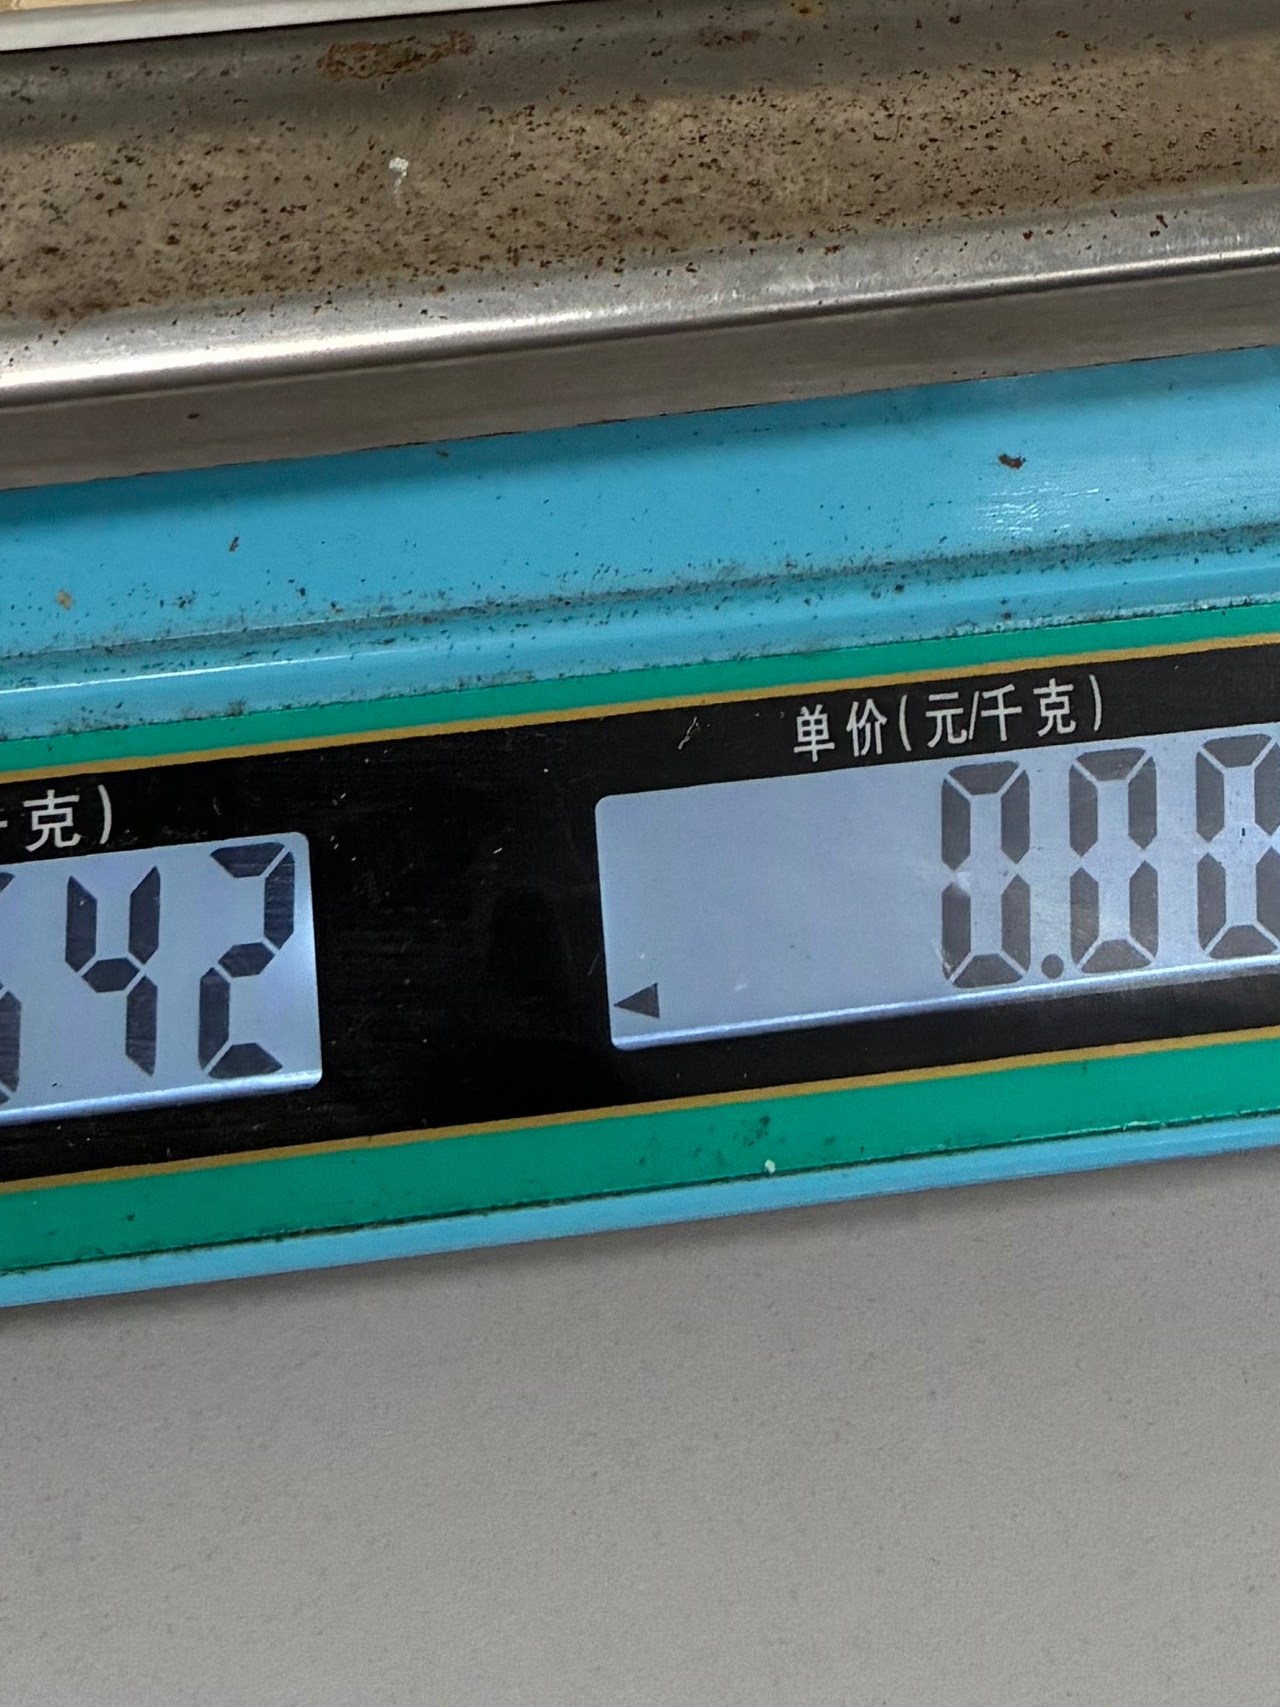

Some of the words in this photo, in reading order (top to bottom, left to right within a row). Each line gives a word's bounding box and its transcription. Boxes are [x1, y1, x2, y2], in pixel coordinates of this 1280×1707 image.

[793, 675, 1104, 761] 单价(元/千克)
